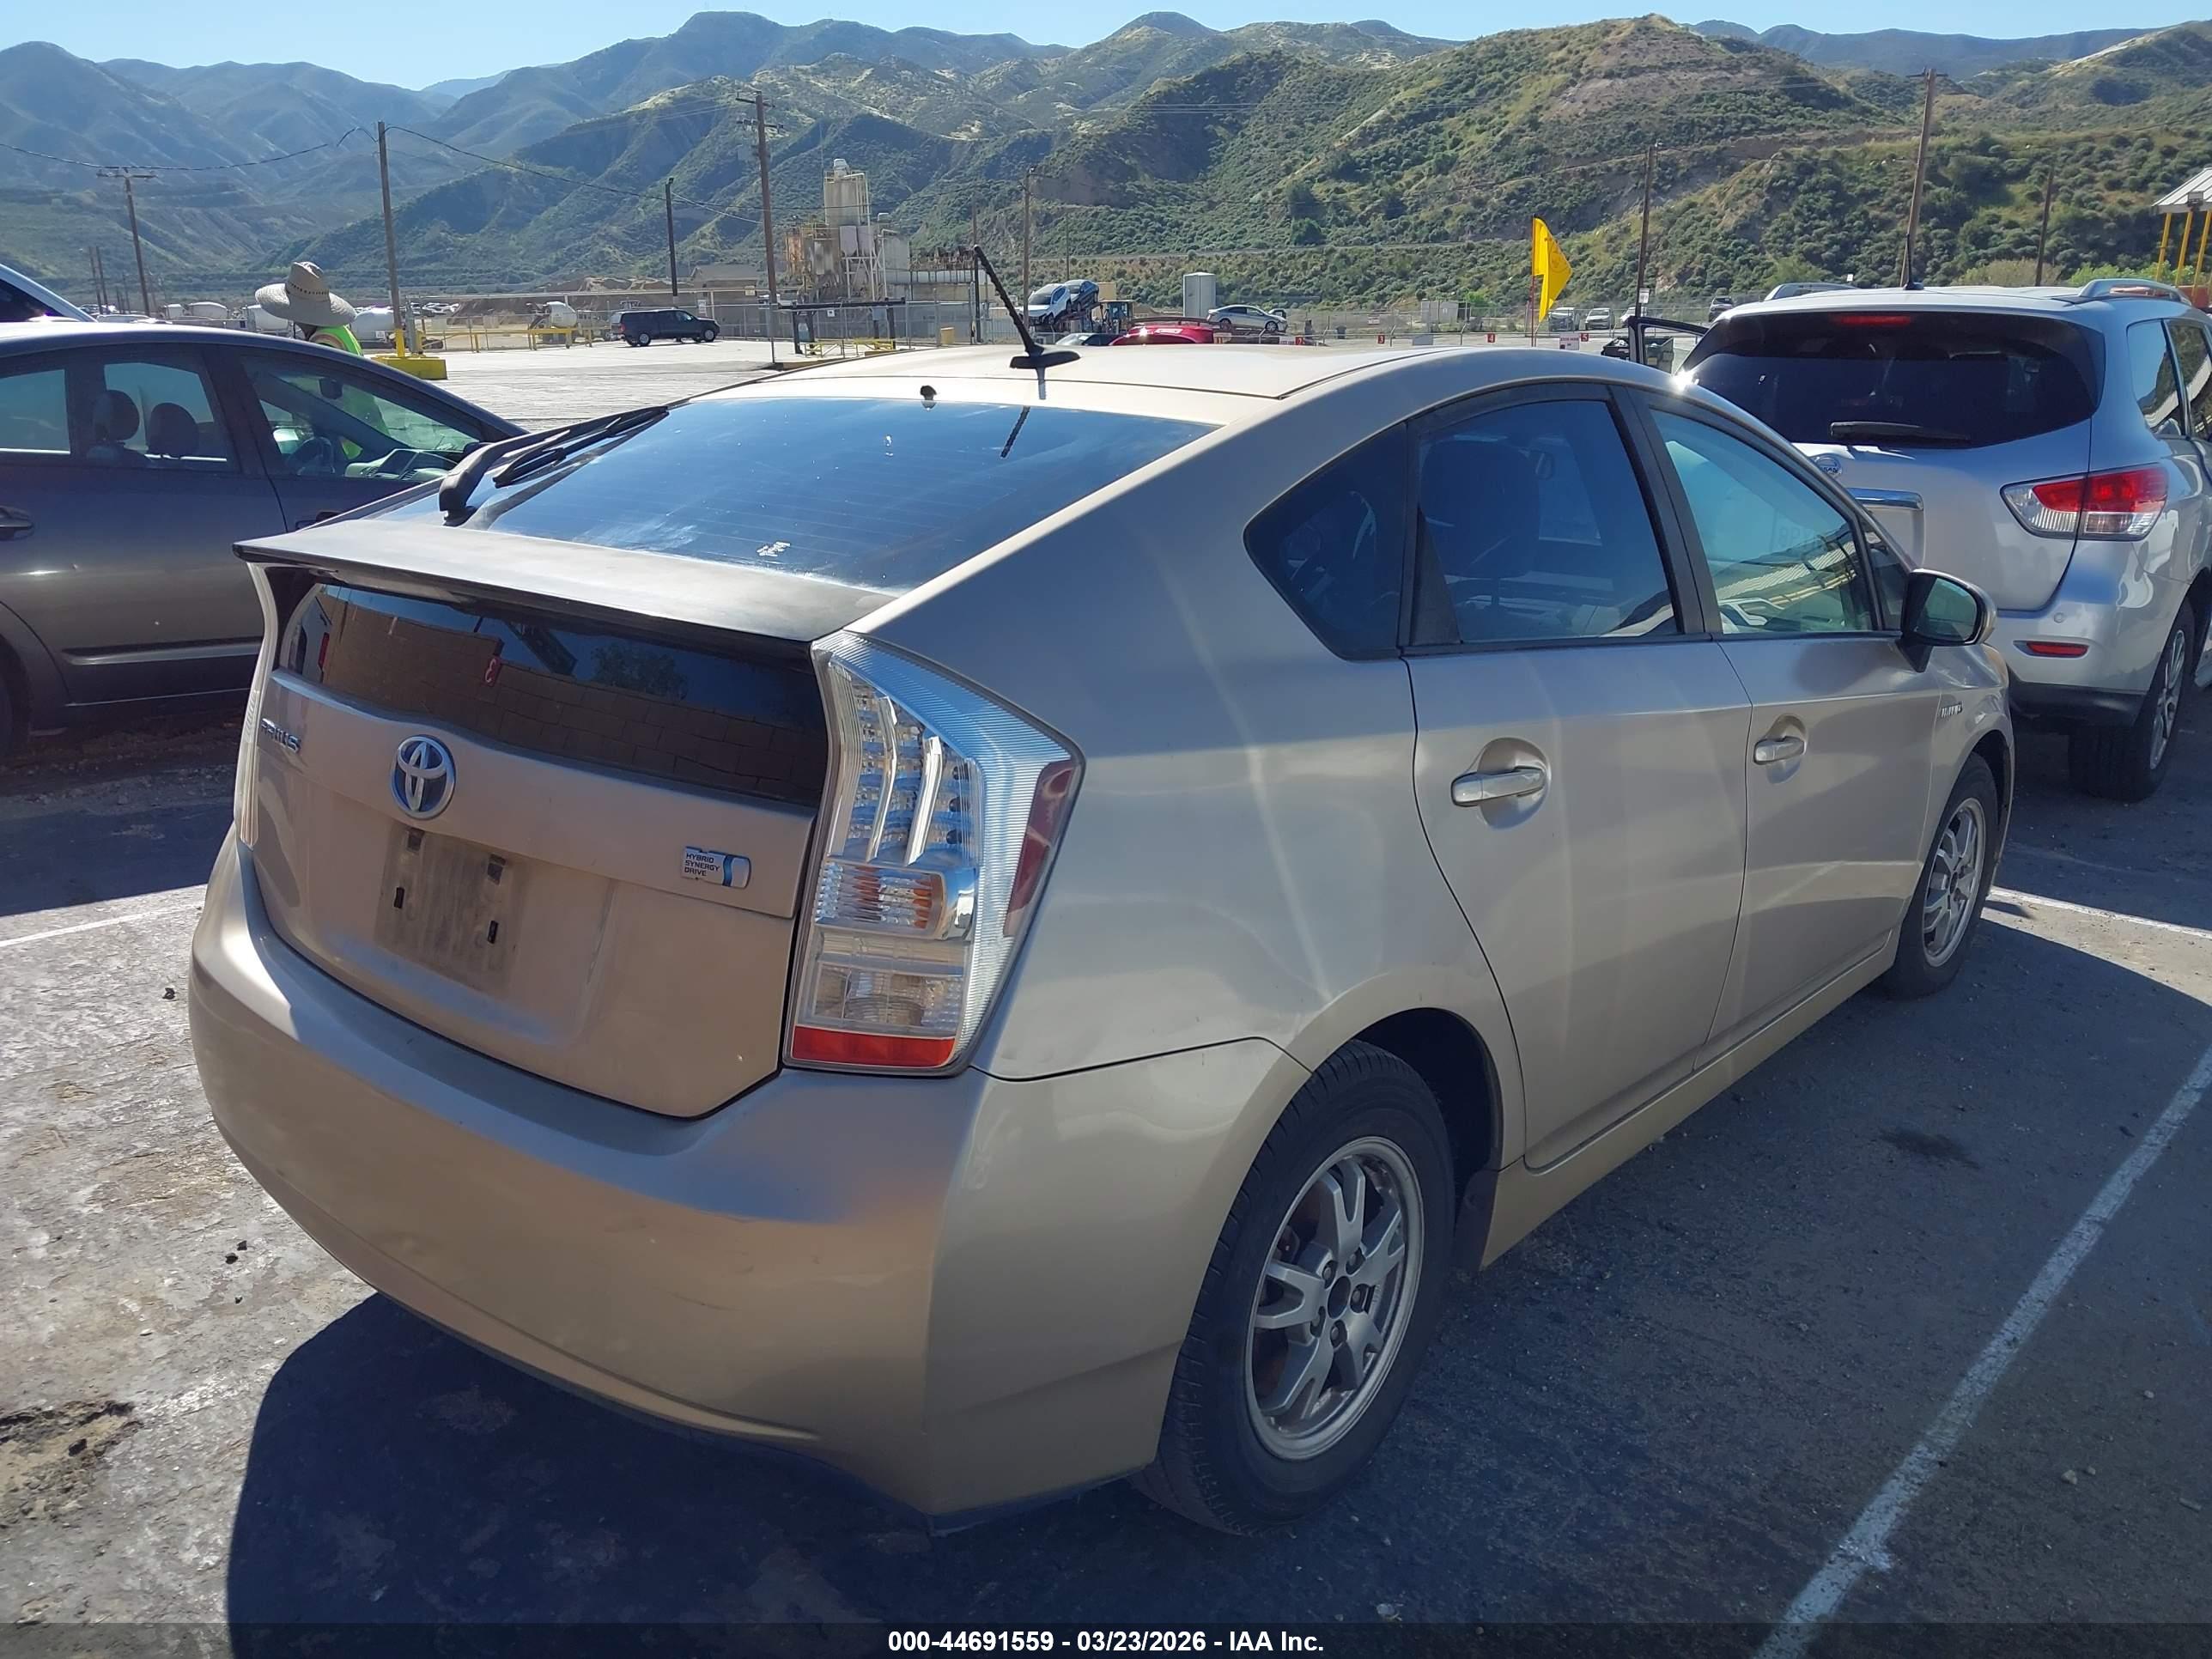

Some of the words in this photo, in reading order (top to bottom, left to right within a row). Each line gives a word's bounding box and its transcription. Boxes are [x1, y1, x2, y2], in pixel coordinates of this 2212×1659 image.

[685, 852, 714, 864] HYBRID
[684, 860, 720, 872] SYNERGY
[684, 866, 707, 876] DRIVE
